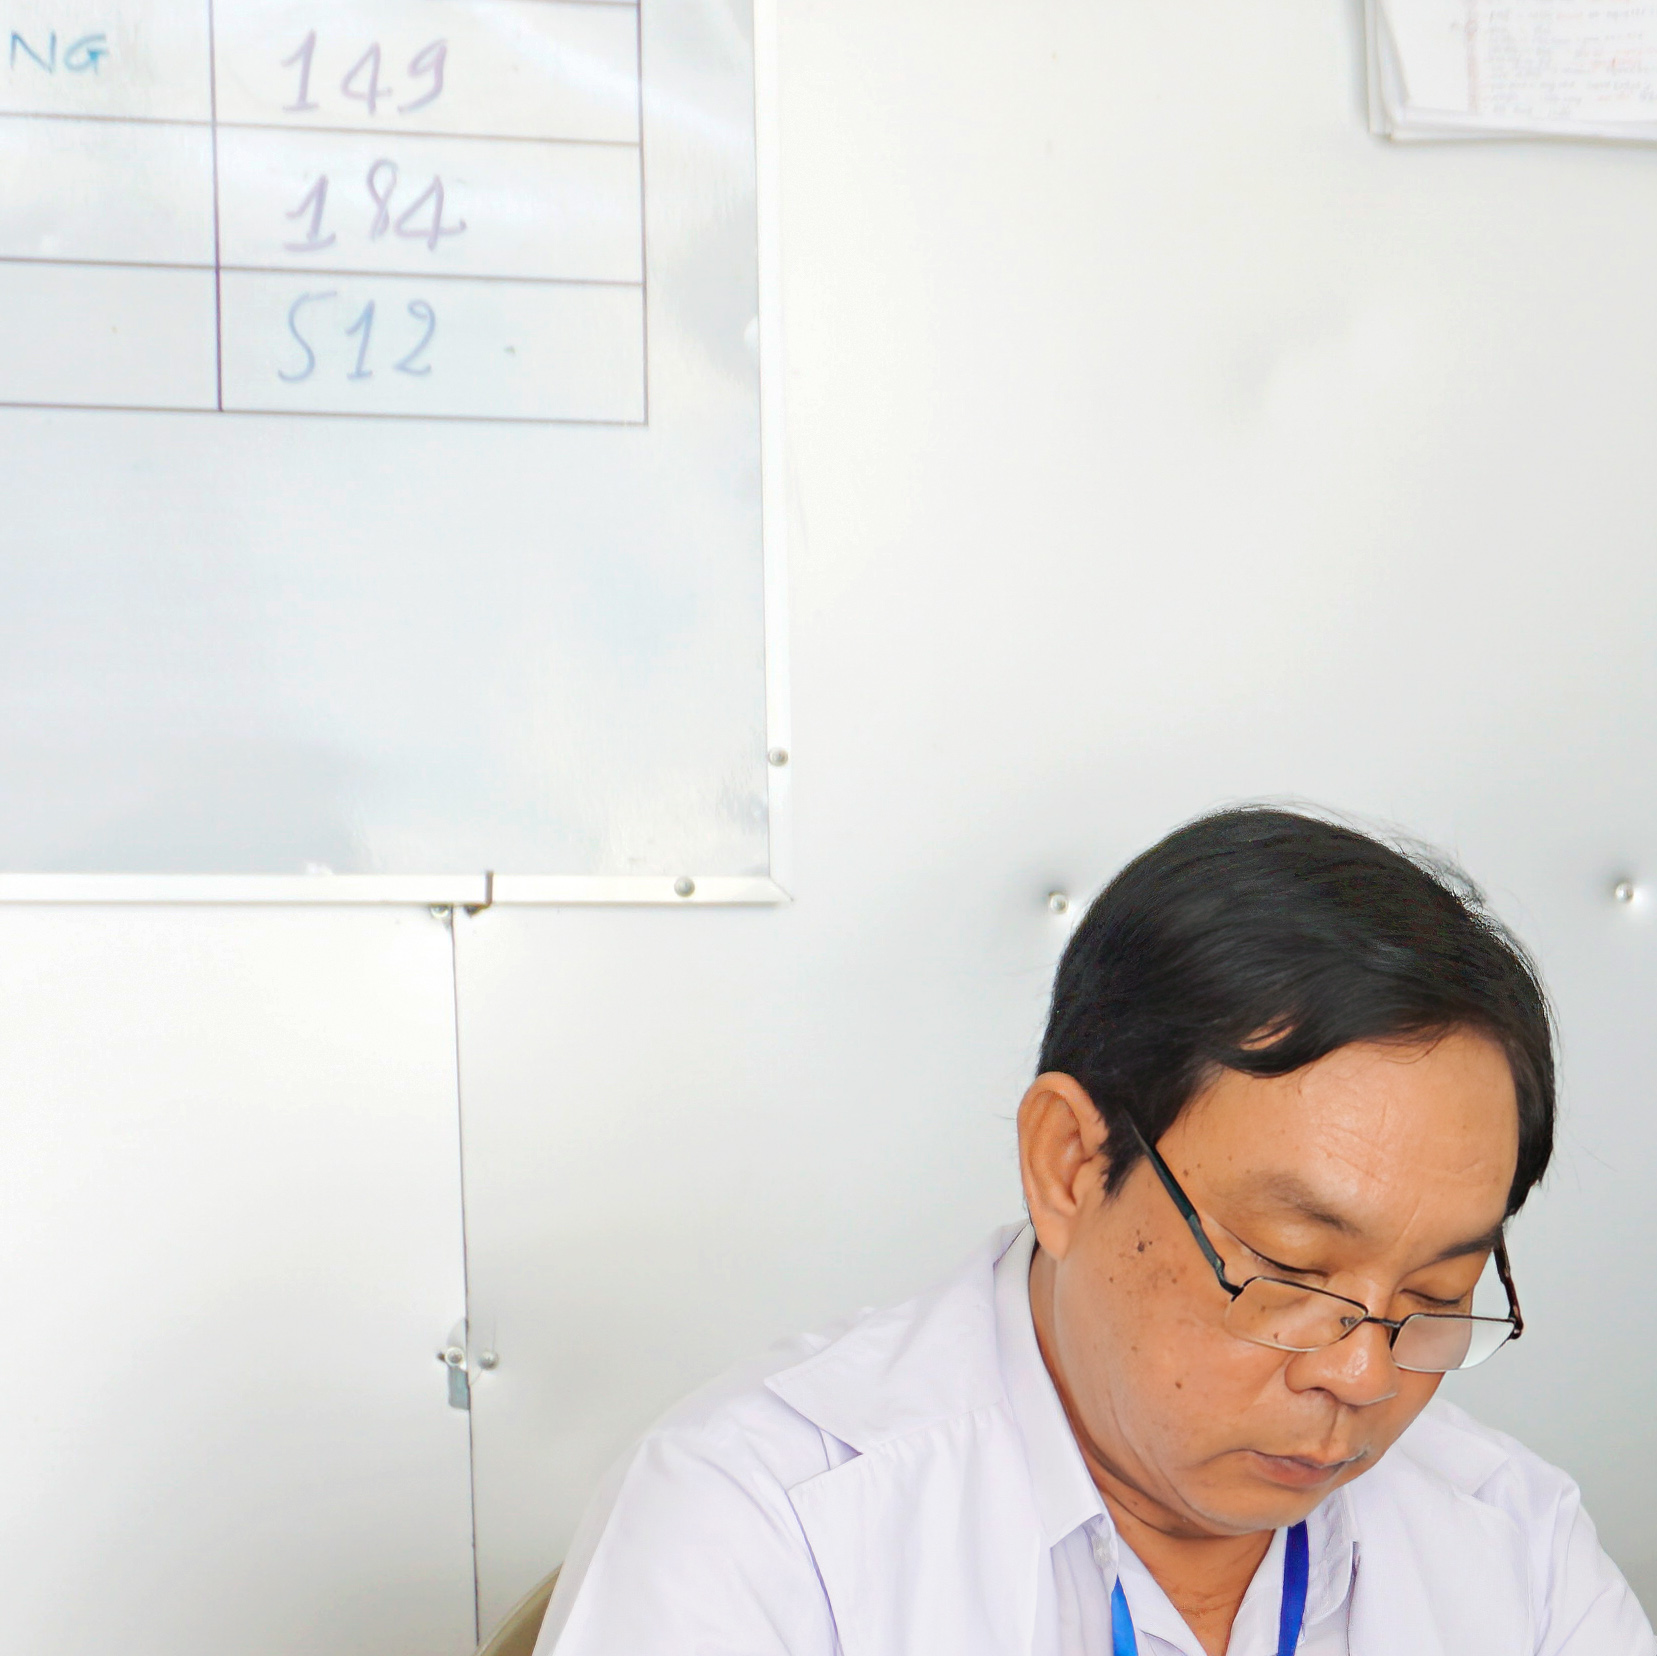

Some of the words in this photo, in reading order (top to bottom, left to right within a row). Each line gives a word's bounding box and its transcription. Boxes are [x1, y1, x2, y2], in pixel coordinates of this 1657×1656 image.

[9, 30, 108, 75] NG
[280, 28, 448, 117] 149
[282, 159, 467, 252] 184
[278, 292, 438, 383] 512
